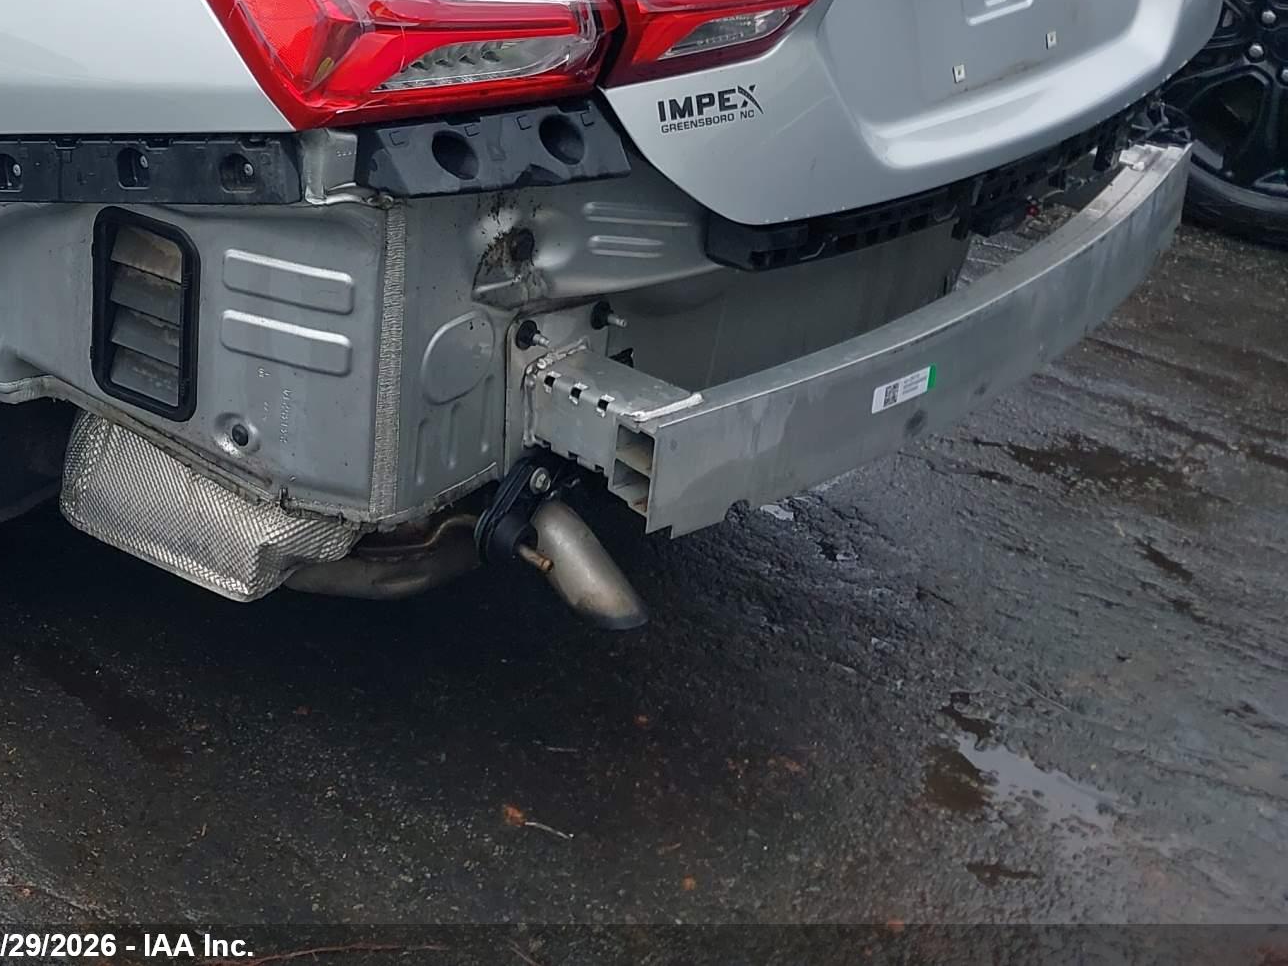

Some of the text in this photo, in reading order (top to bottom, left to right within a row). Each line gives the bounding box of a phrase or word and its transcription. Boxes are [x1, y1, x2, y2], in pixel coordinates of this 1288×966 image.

[657, 84, 764, 123] IMPEX
[660, 109, 755, 134] GREENSBORO NC
